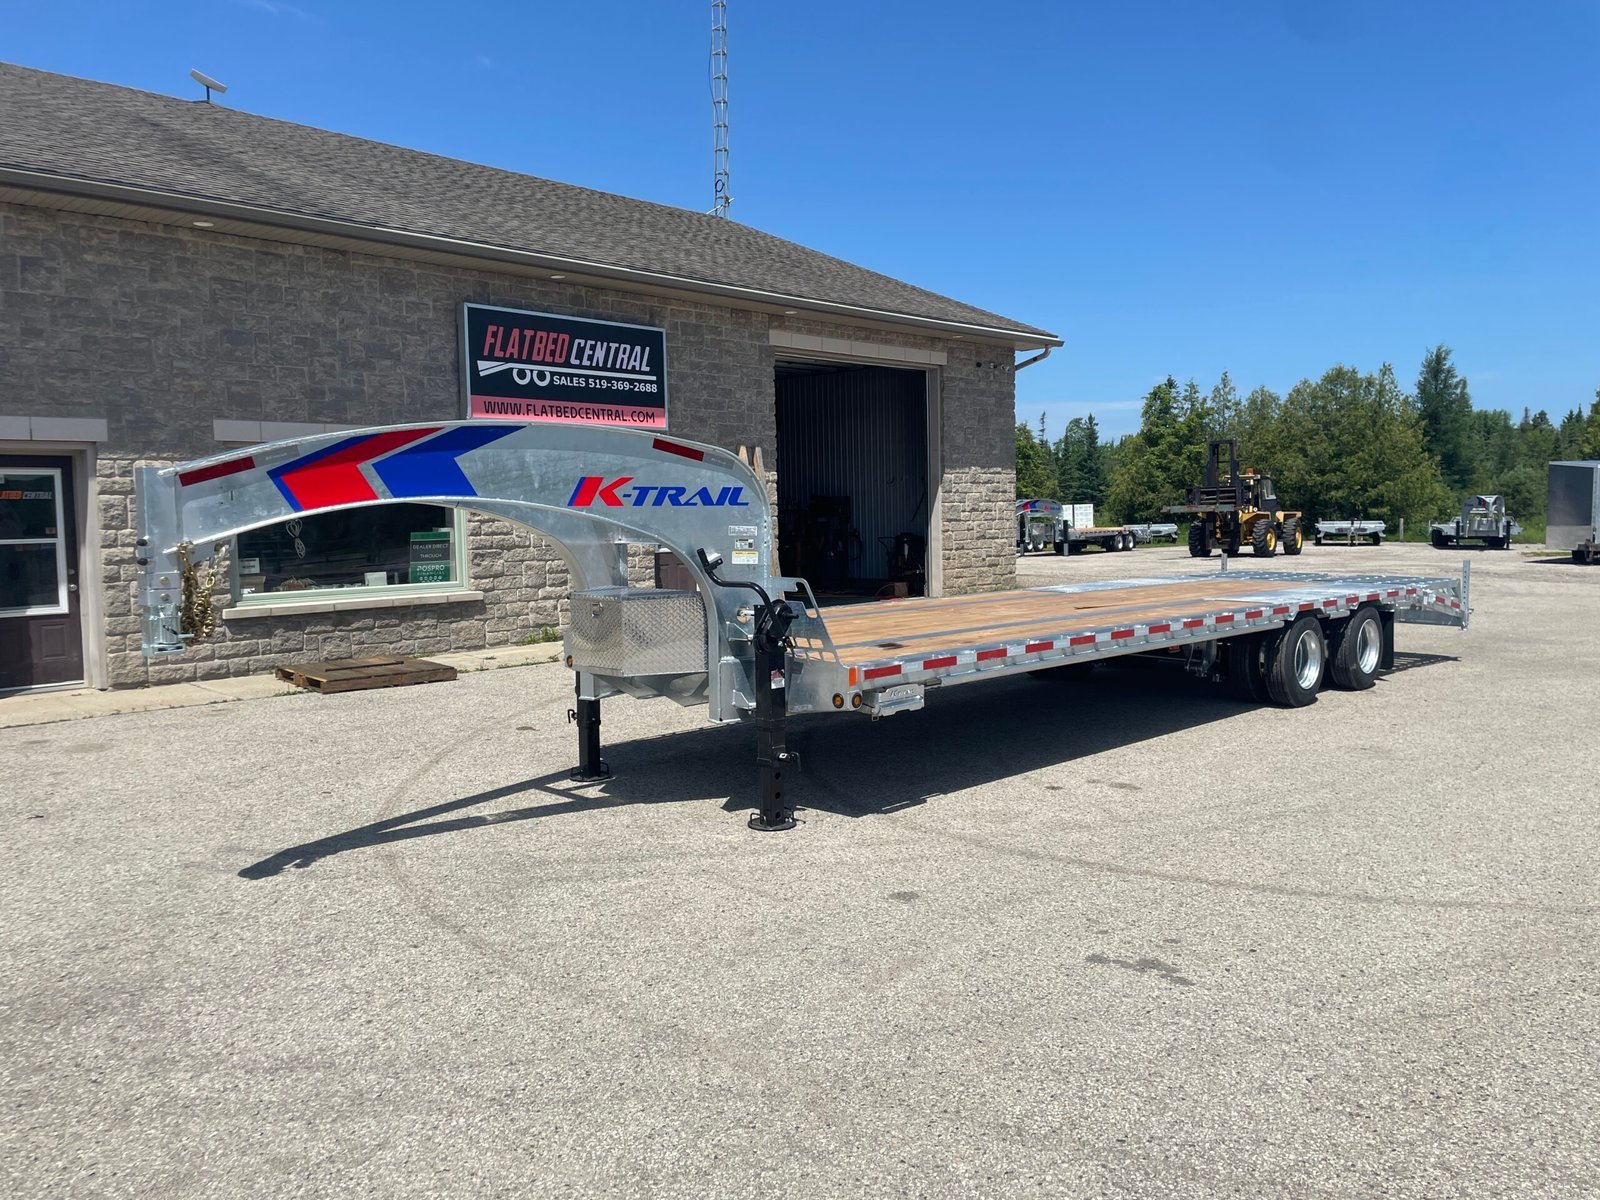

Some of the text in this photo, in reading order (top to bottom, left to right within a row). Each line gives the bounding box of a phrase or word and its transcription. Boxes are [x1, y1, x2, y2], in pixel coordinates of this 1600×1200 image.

[483, 325, 651, 372] FLATBED CENTRAL
[553, 375, 658, 393] SALES 519-369-2688
[483, 401, 656, 424] WWW.FLATBEDCENTRAL.COM
[567, 476, 750, 507] K-TRAIL
